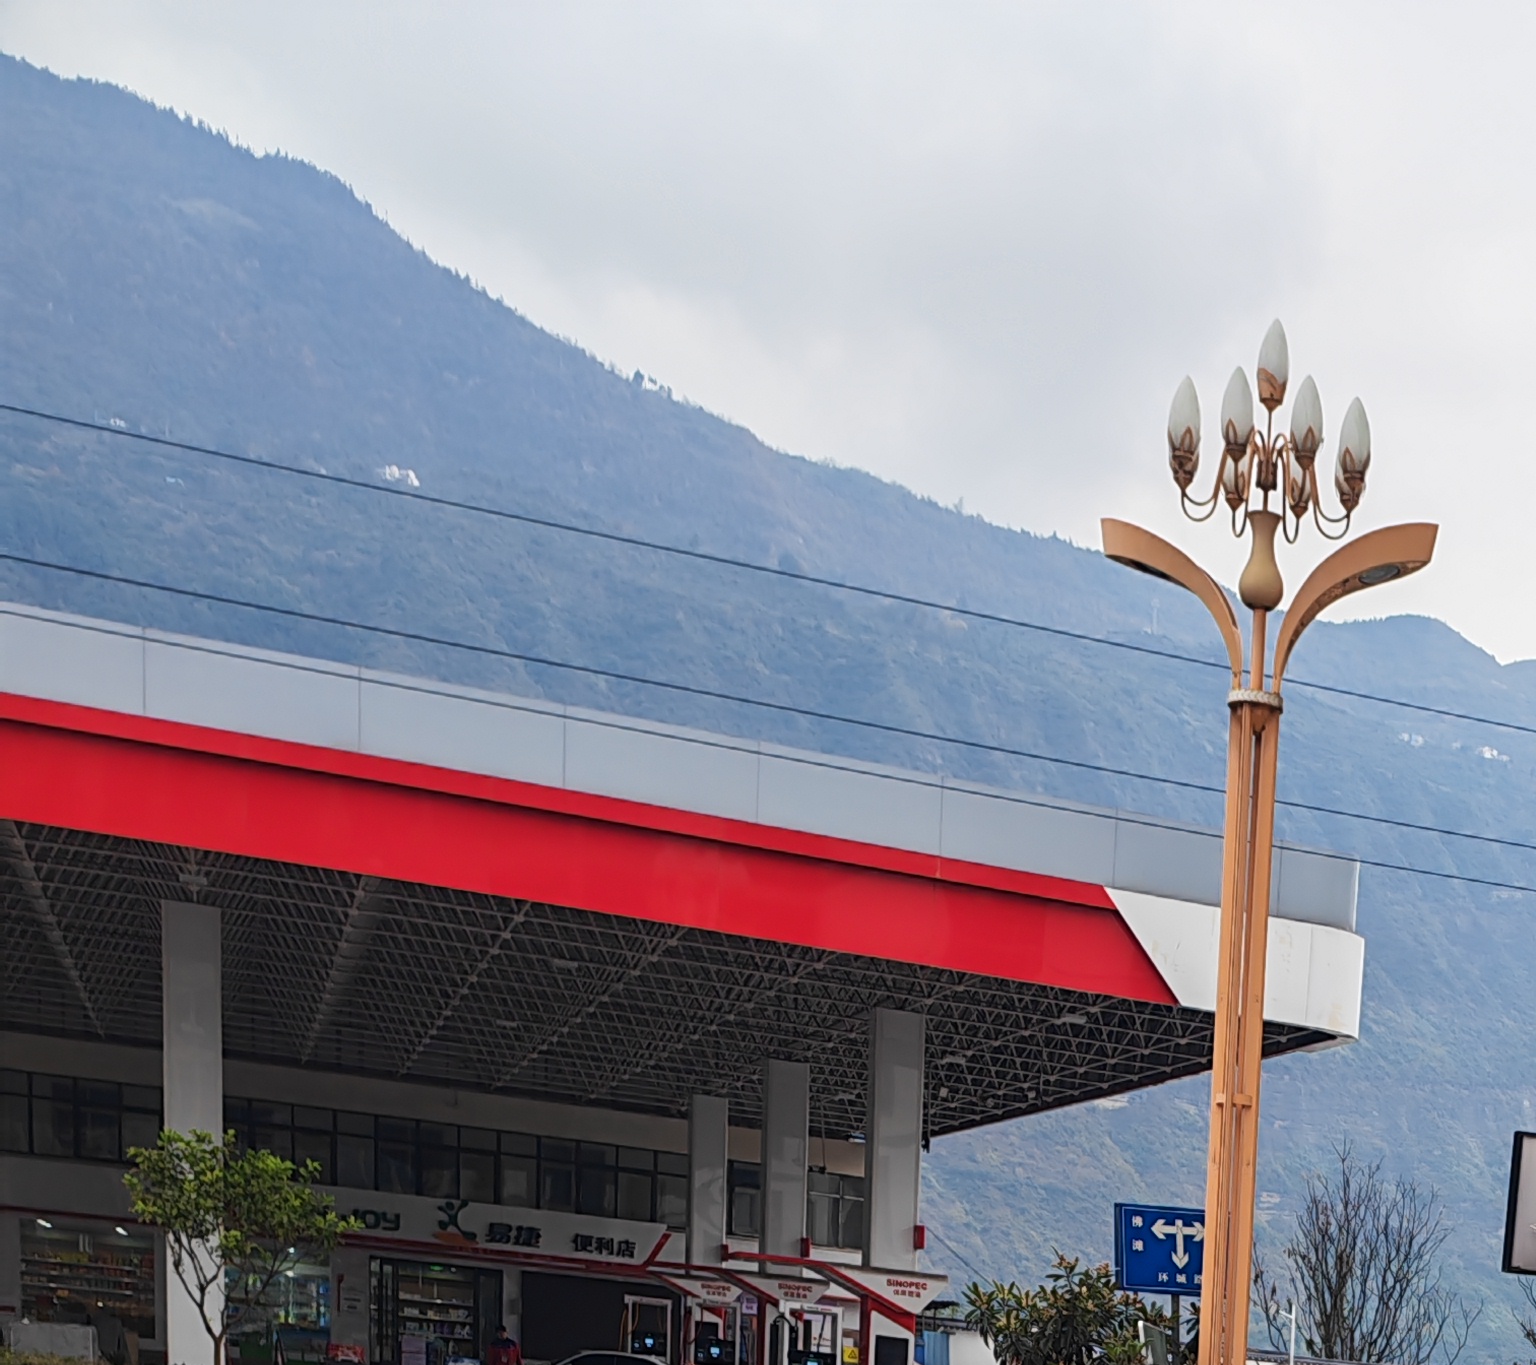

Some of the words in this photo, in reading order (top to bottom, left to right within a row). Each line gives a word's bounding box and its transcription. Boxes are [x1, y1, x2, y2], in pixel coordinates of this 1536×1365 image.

[485, 1222, 541, 1248] 易捷
[571, 1232, 636, 1259] 便利店
[886, 1278, 927, 1291] SINOPEC
